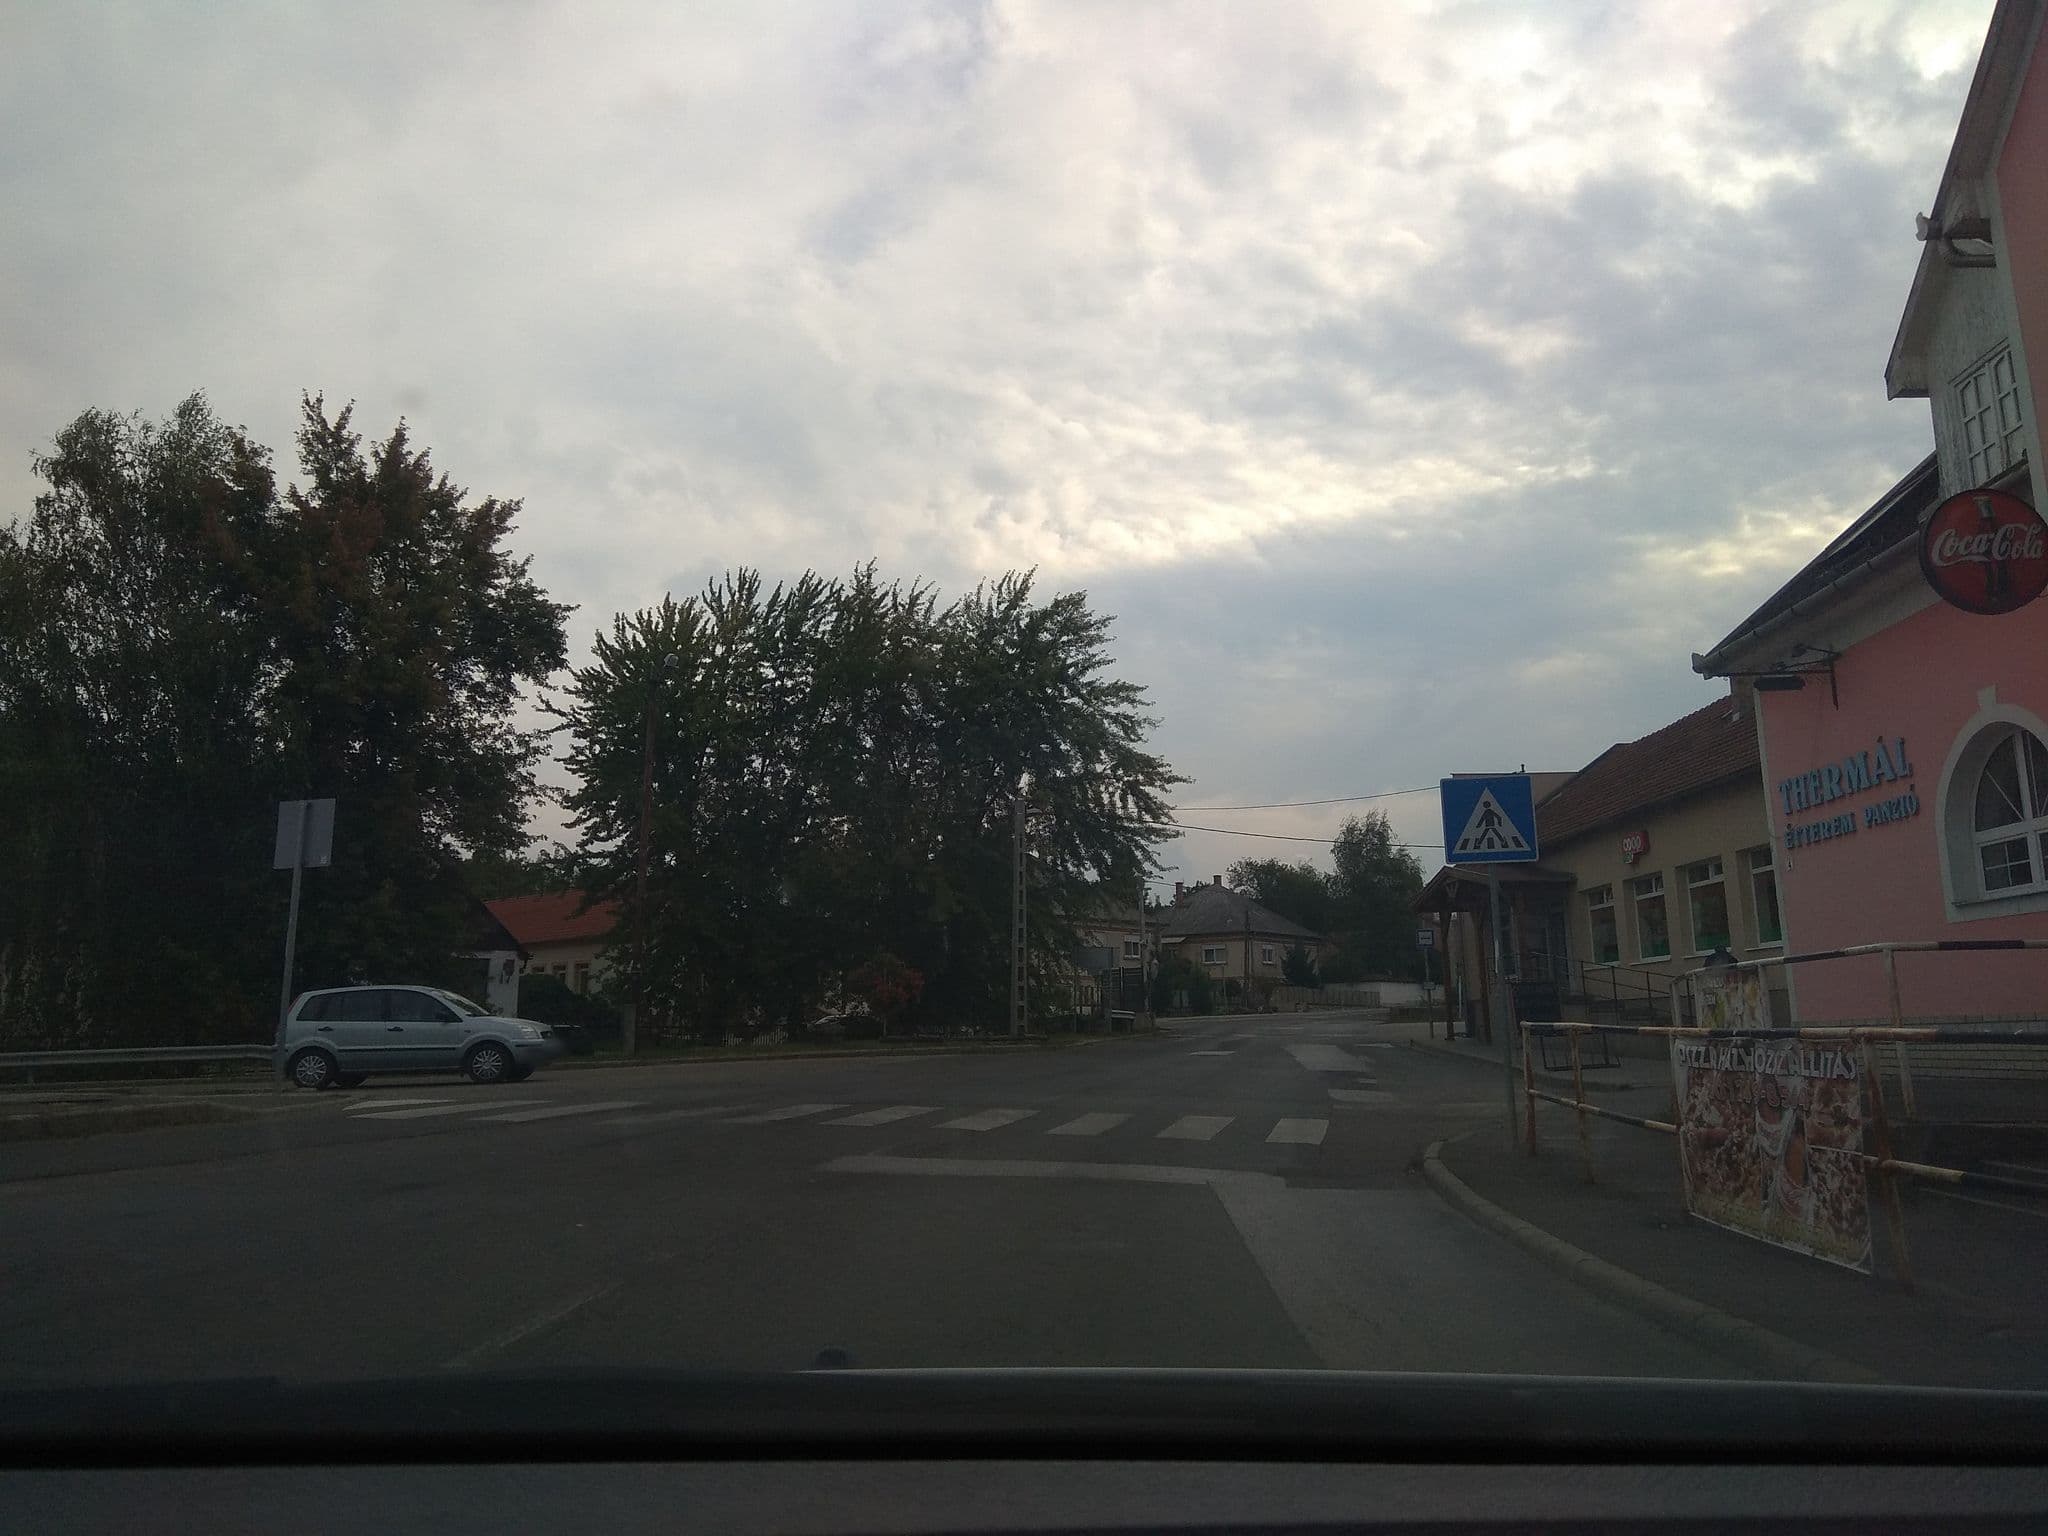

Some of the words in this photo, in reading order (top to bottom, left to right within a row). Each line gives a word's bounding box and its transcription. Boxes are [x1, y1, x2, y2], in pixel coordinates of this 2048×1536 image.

[1931, 523, 2043, 567] Coca-Cola
[1777, 736, 1913, 816] THERMÁL
[1863, 784, 1920, 828] PANZIÓ
